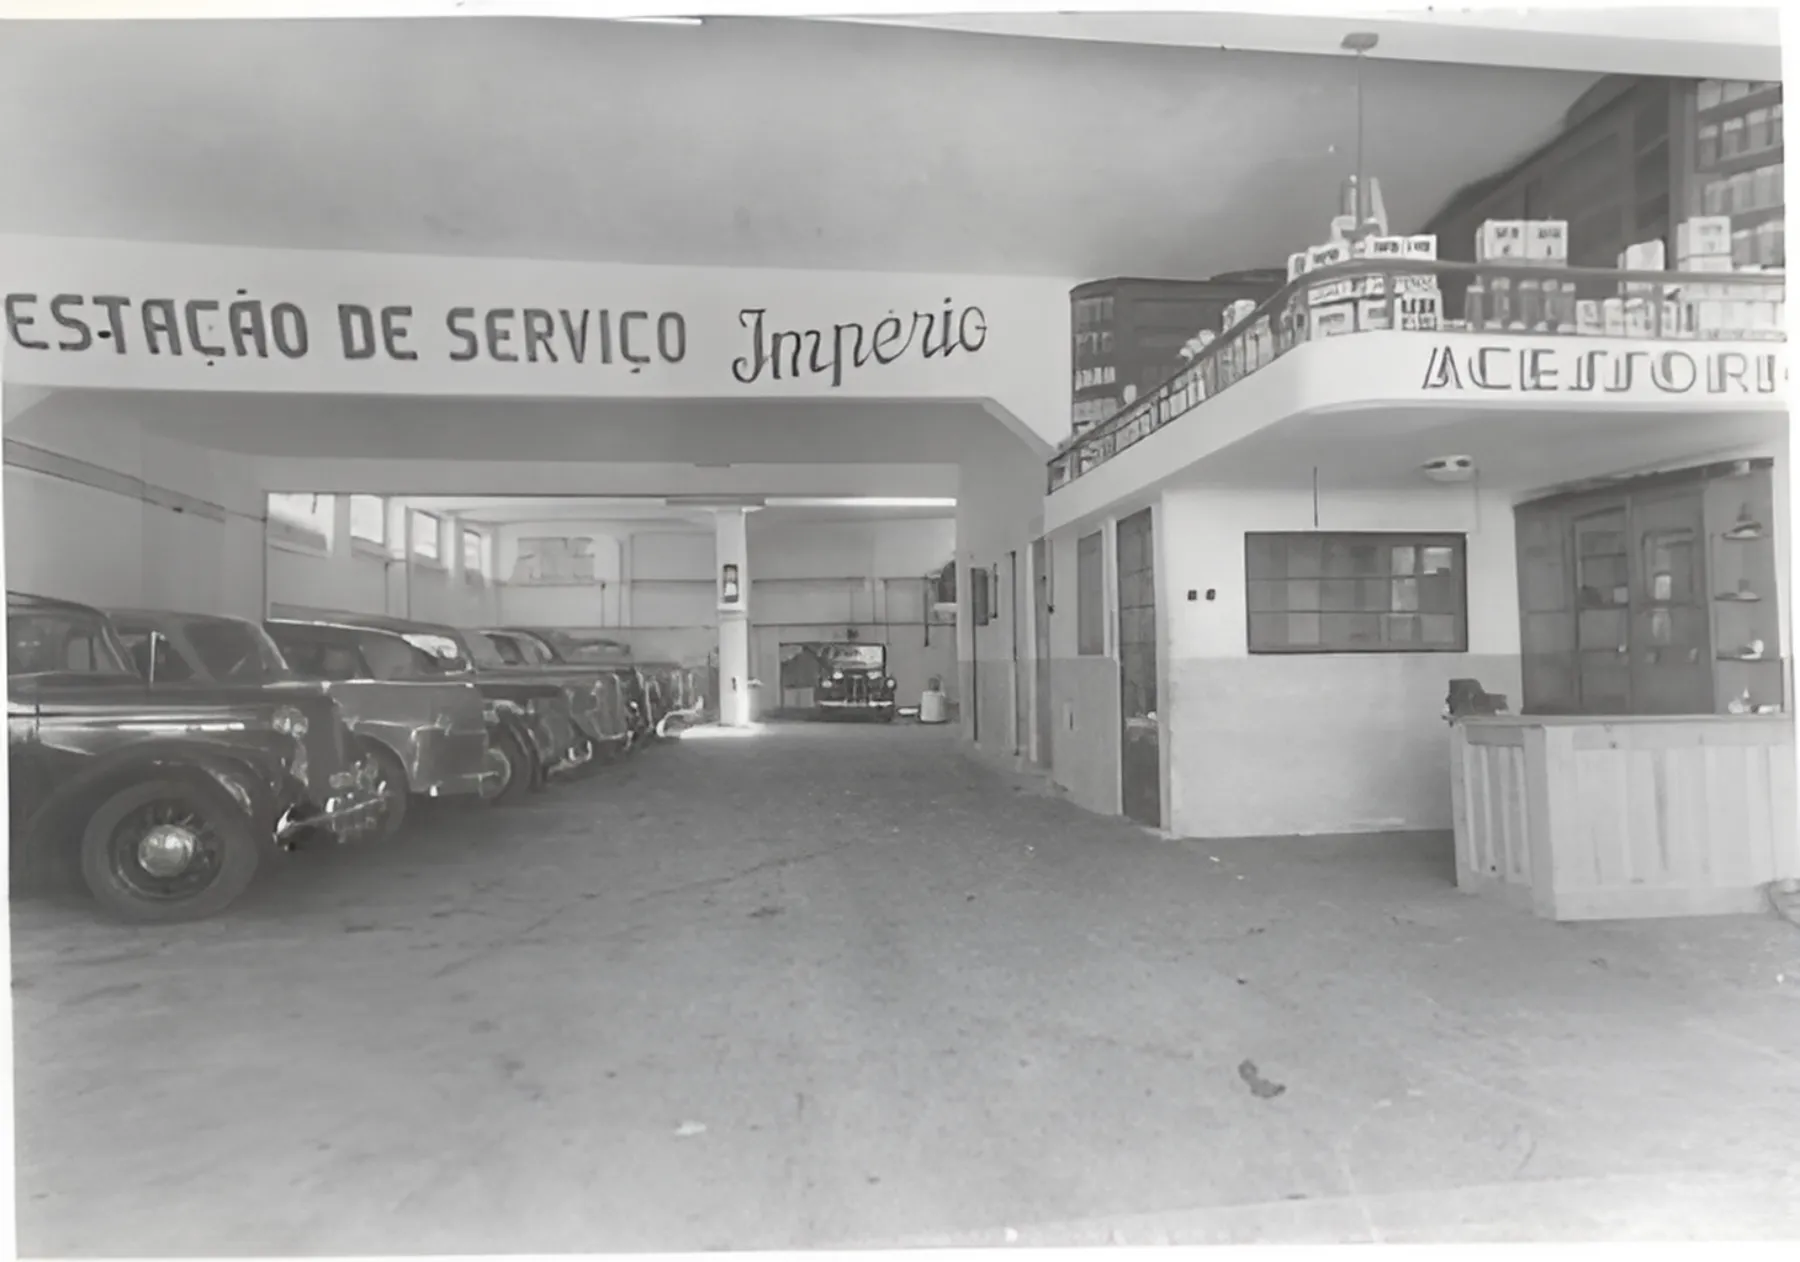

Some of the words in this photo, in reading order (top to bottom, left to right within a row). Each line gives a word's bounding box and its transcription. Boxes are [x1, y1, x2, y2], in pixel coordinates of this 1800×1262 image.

[338, 304, 418, 361] DE
[447, 307, 686, 374] SERVIÇO
[732, 297, 988, 387] Império
[1421, 345, 1789, 393] ACESSORI
